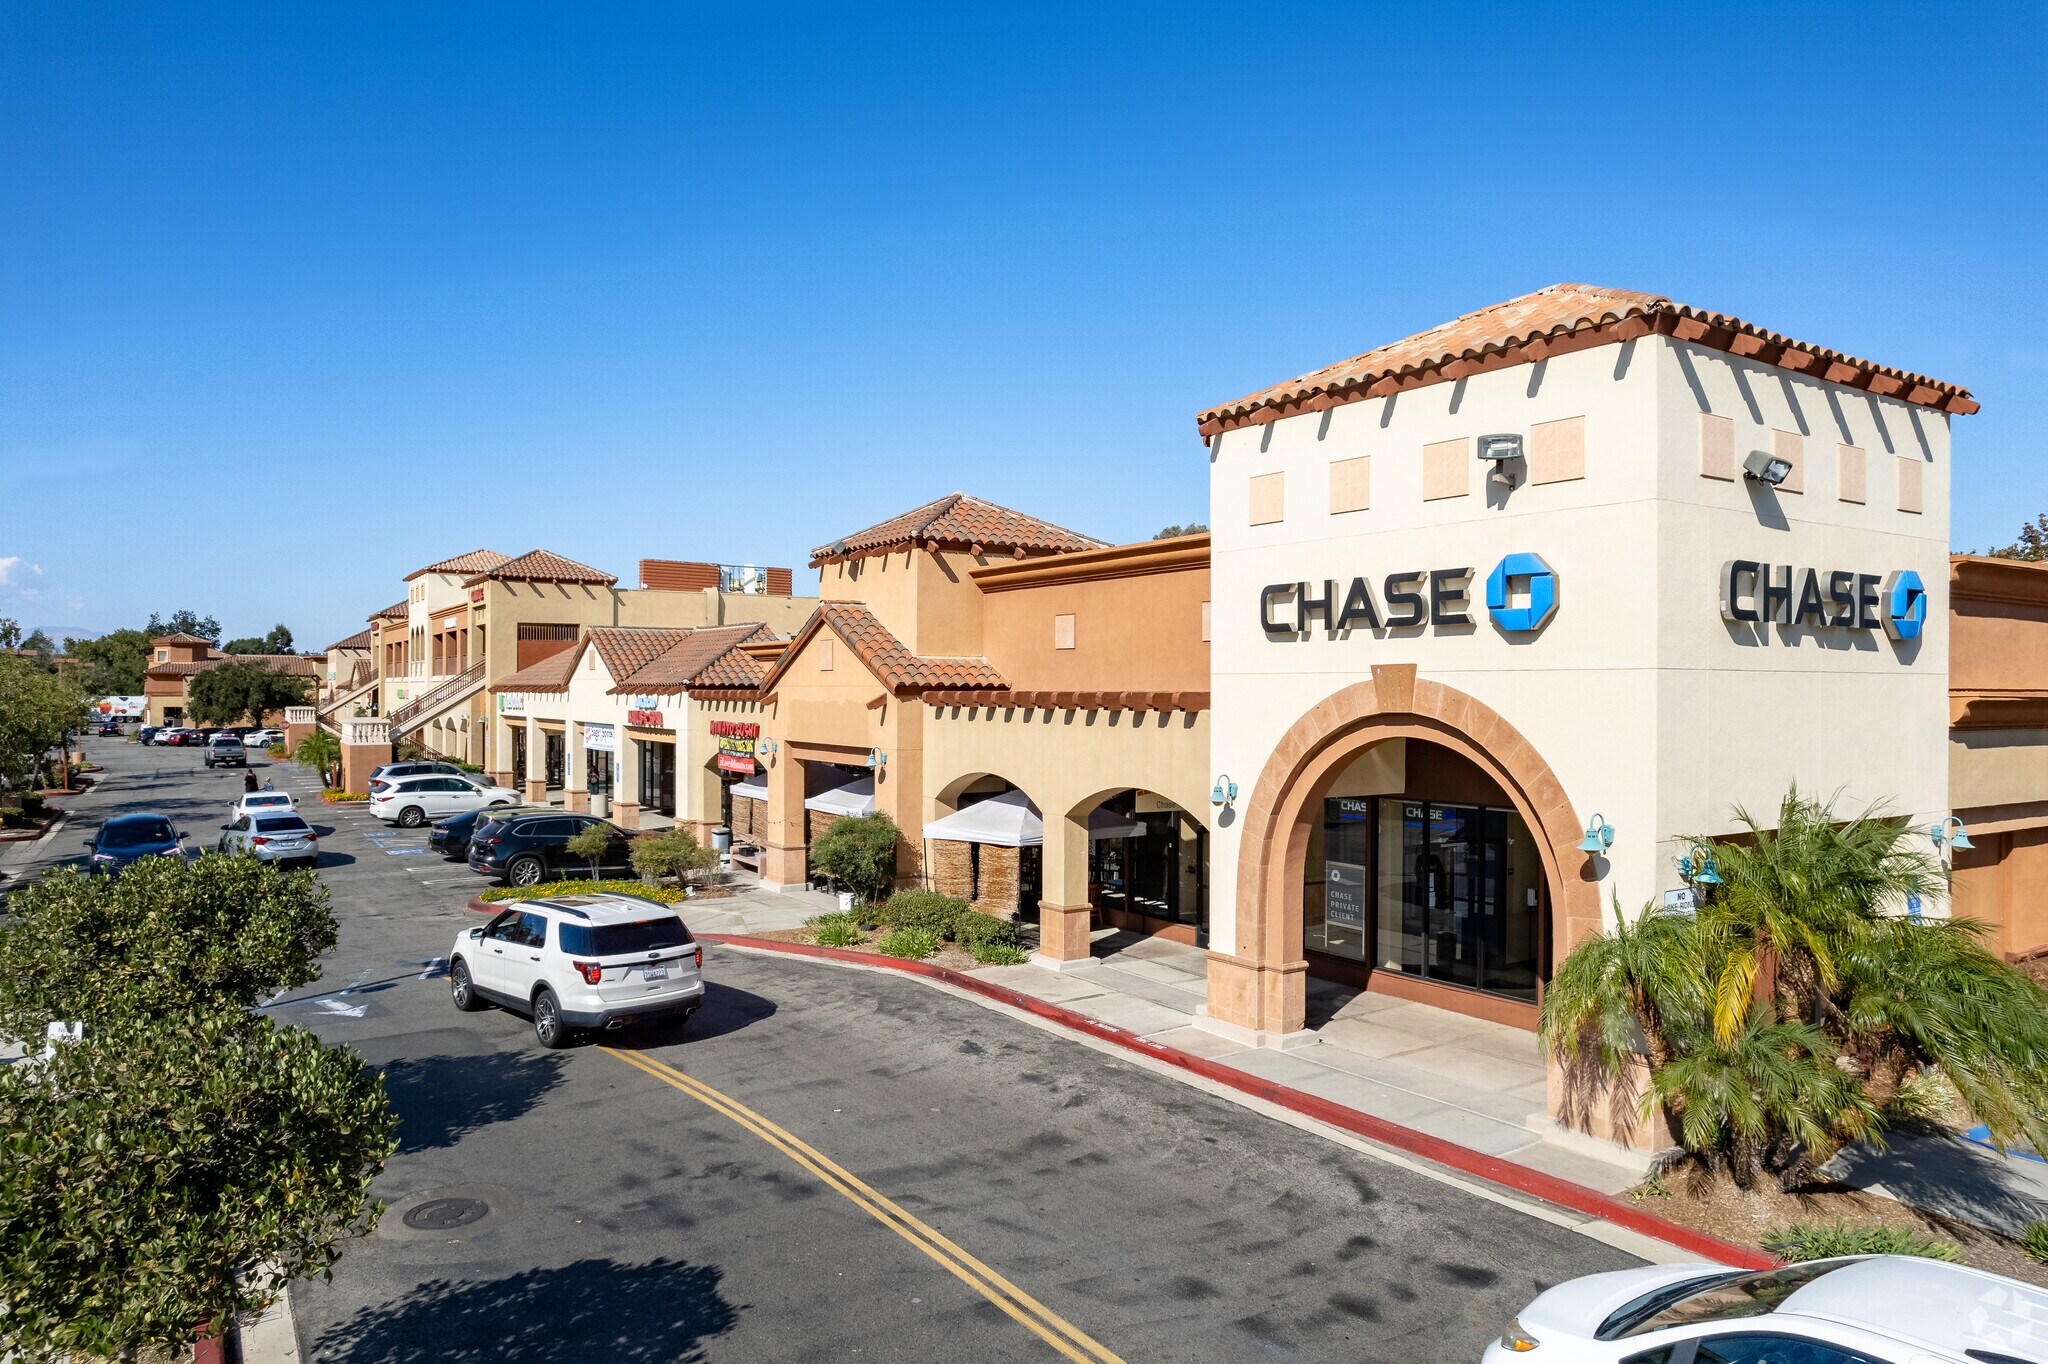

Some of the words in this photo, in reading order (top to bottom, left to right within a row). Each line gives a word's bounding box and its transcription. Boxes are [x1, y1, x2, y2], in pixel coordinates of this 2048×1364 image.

[1260, 567, 1474, 633] CHASE
[1721, 559, 1882, 630] CHASE
[1341, 800, 1367, 812] CHAS
[1330, 890, 1353, 901] CHASE
[1677, 892, 1686, 900] NO
[1330, 900, 1360, 913] PRIVATE
[1330, 910, 1355, 921] CLIENT
